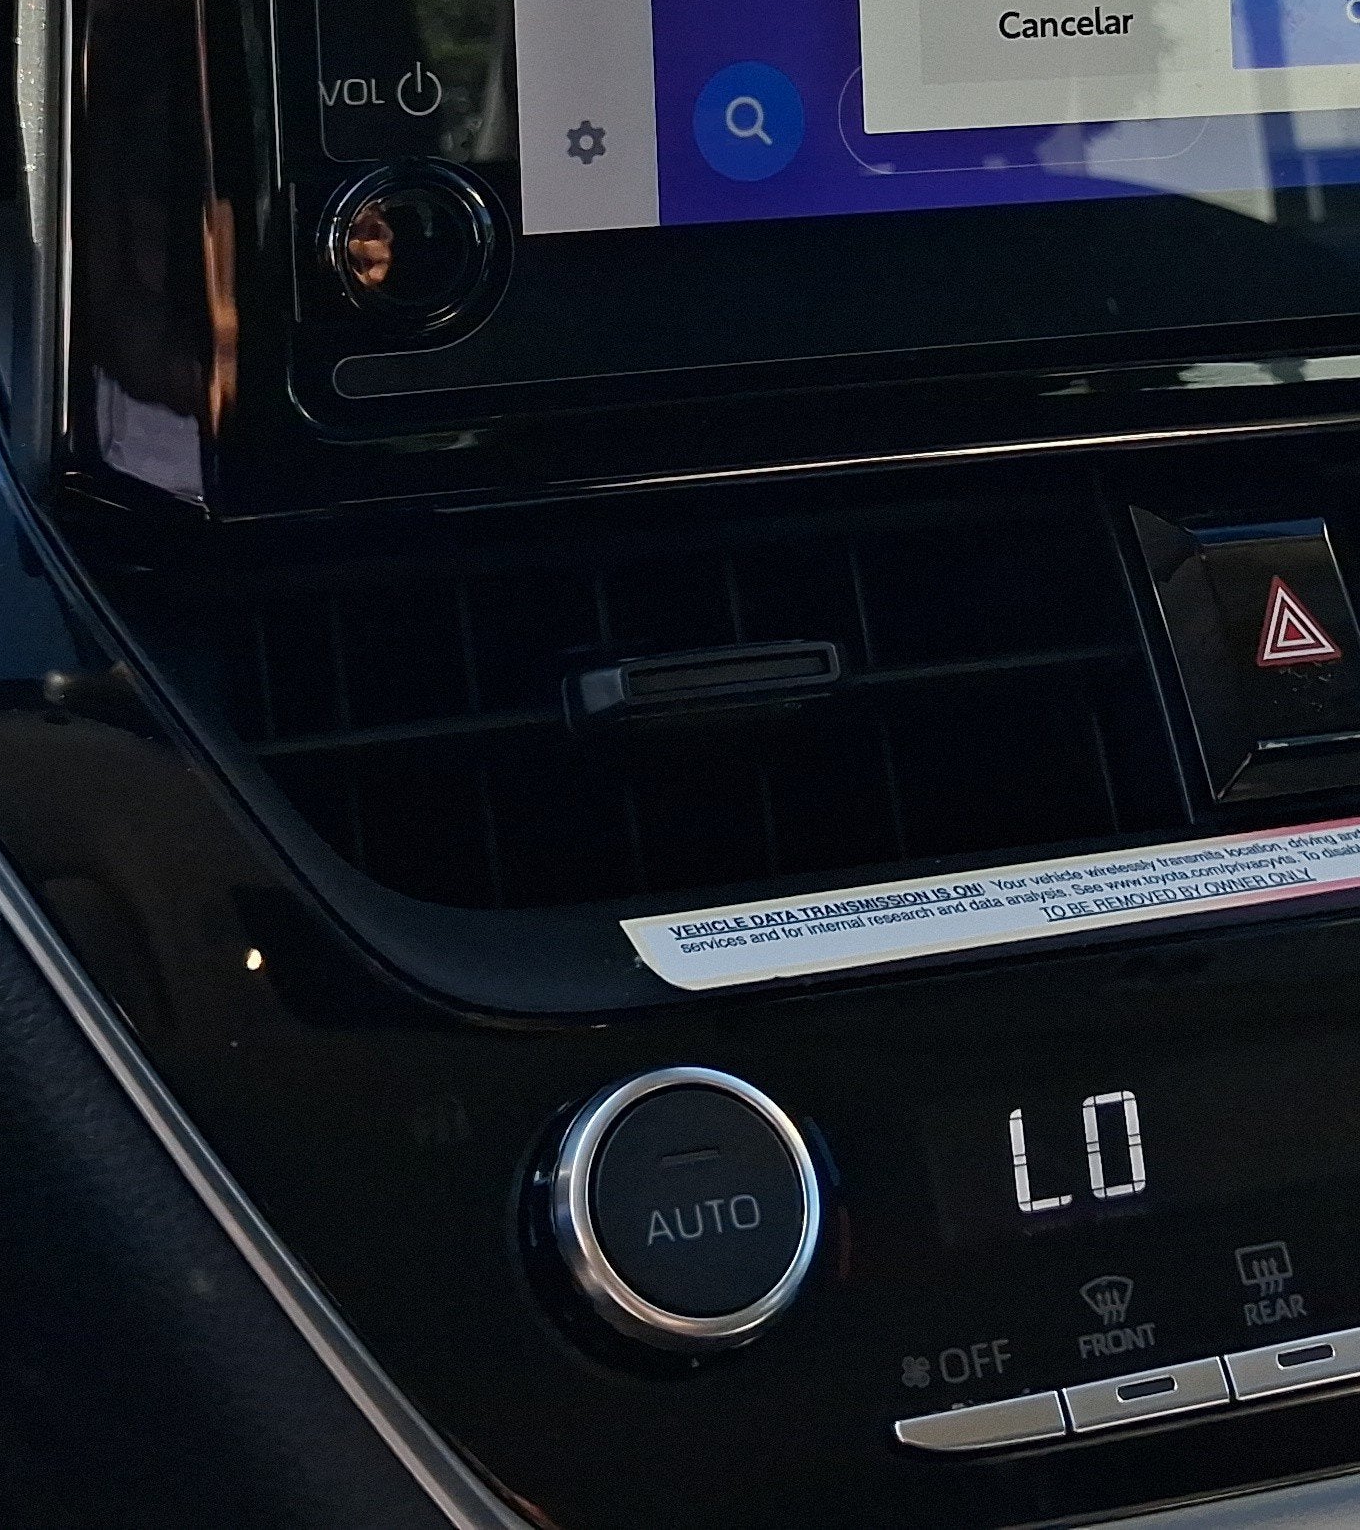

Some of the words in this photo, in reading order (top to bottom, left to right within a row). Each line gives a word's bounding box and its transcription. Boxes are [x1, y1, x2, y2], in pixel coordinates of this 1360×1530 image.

[998, 6, 1134, 39] Cancelar
[318, 78, 385, 106] VOL
[668, 916, 749, 938] VEHICLE
[749, 911, 797, 930] DATA
[797, 890, 929, 920] TRANSMISSION
[930, 886, 951, 901] IS
[990, 876, 1028, 891] Your
[1030, 868, 1083, 887] vehicle
[1084, 859, 1156, 878] wirelessly
[1156, 850, 1226, 868] transmits
[1288, 830, 1336, 848] driving
[680, 934, 747, 954] services
[749, 929, 780, 945] and
[781, 925, 806, 940] for
[807, 915, 866, 935] internal
[868, 906, 935, 927] research
[939, 901, 968, 917] and
[969, 897, 1005, 912] data
[1006, 886, 1072, 906] analysis.
[1071, 881, 1104, 896] See
[1301, 849, 1321, 862] To
[1040, 904, 1067, 920] TO
[1067, 900, 1093, 916] BE
[1093, 888, 1178, 912] REMOVED
[1178, 883, 1202, 900] BY
[1202, 873, 1267, 895] OWNER
[1267, 866, 1314, 885] ONLY
[647, 1194, 760, 1246] AUTO
[1244, 1293, 1307, 1325] REAR
[940, 1338, 1011, 1384] OFF
[1078, 1321, 1156, 1359] FRONT
